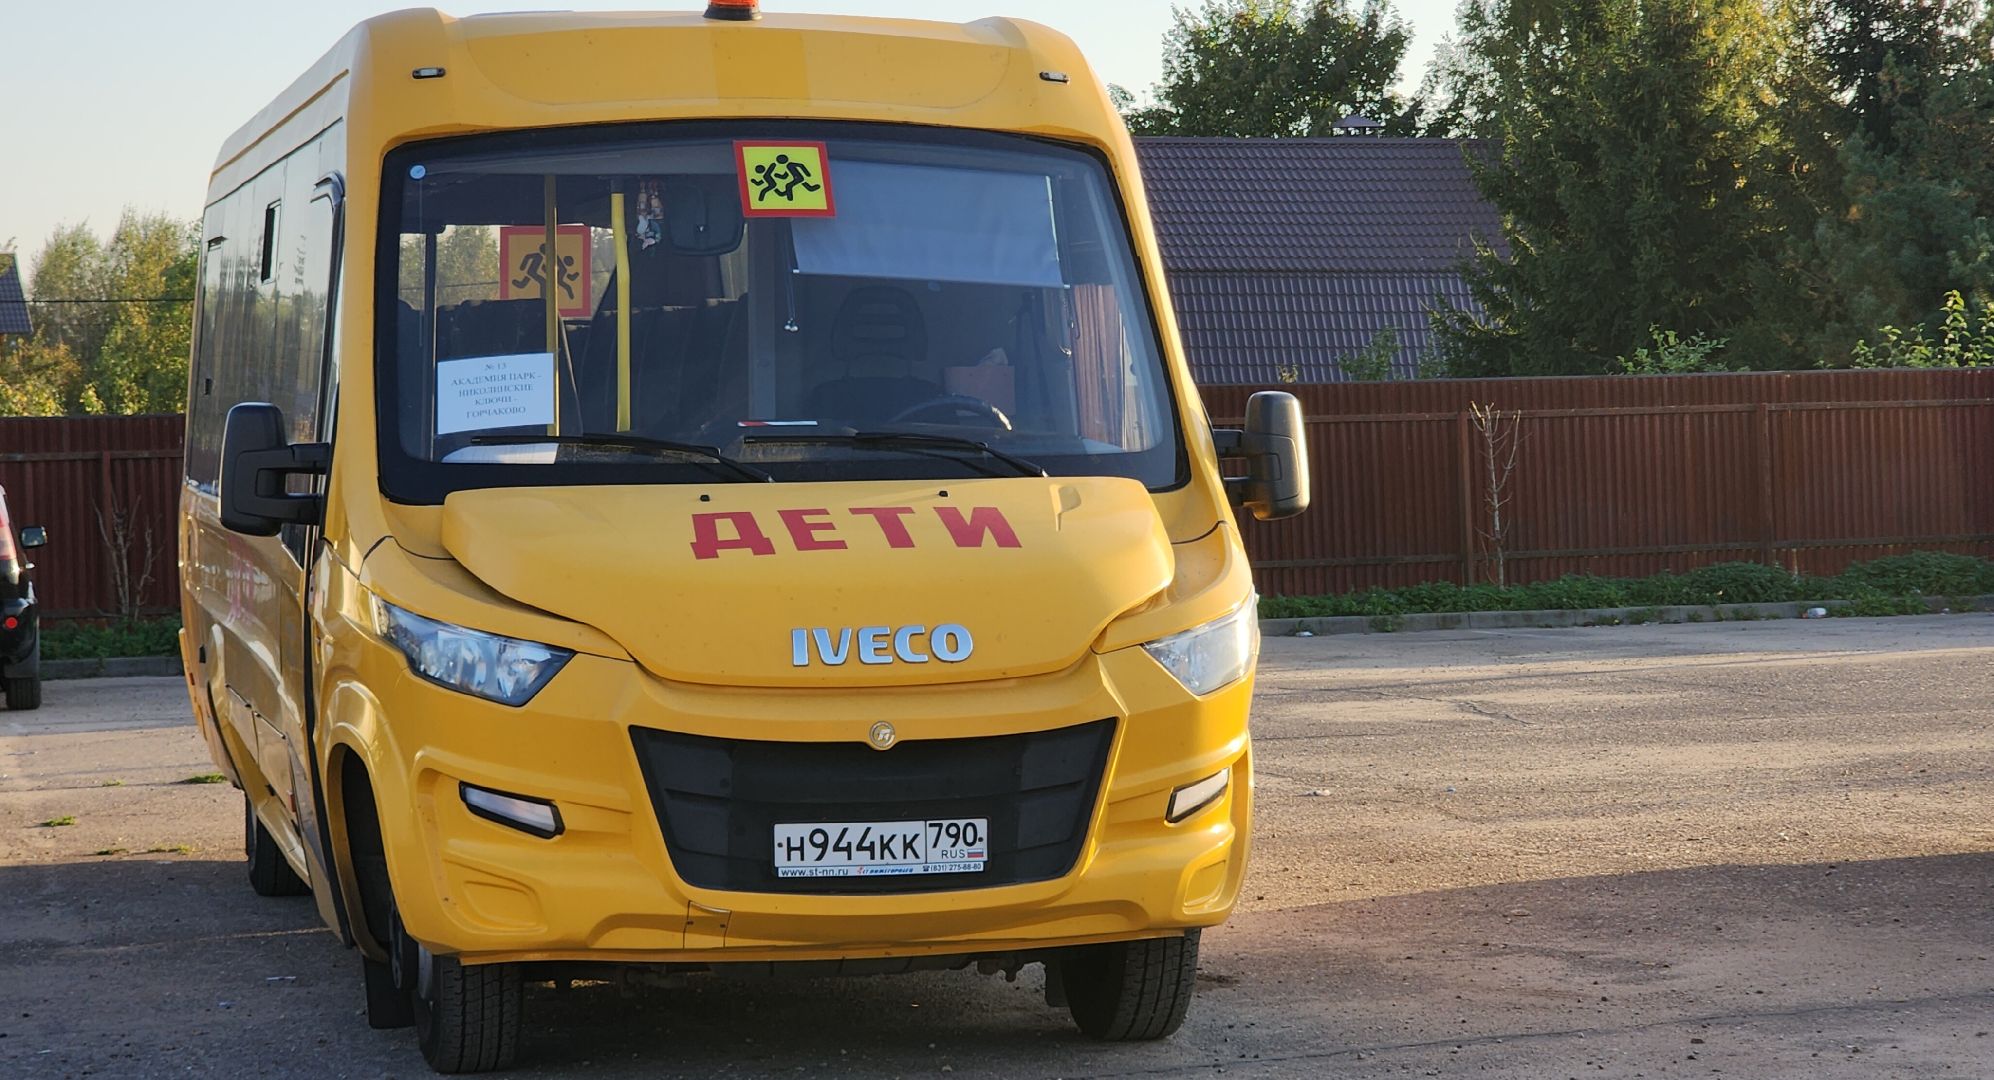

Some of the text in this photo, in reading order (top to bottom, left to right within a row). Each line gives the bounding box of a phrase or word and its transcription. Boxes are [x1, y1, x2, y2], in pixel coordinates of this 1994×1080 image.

[451, 374, 508, 386] АКАДЕМИЯ
[509, 371, 536, 381] ПАРК
[475, 395, 512, 405] КЛЮЧИ
[466, 406, 526, 419] ГОРЧАКОВО
[690, 506, 1023, 560] ДЕТИ
[791, 623, 974, 667] IVECO
[928, 822, 978, 849] 790
[941, 849, 966, 859] RUS
[781, 868, 849, 876] www.st-nn.ru
